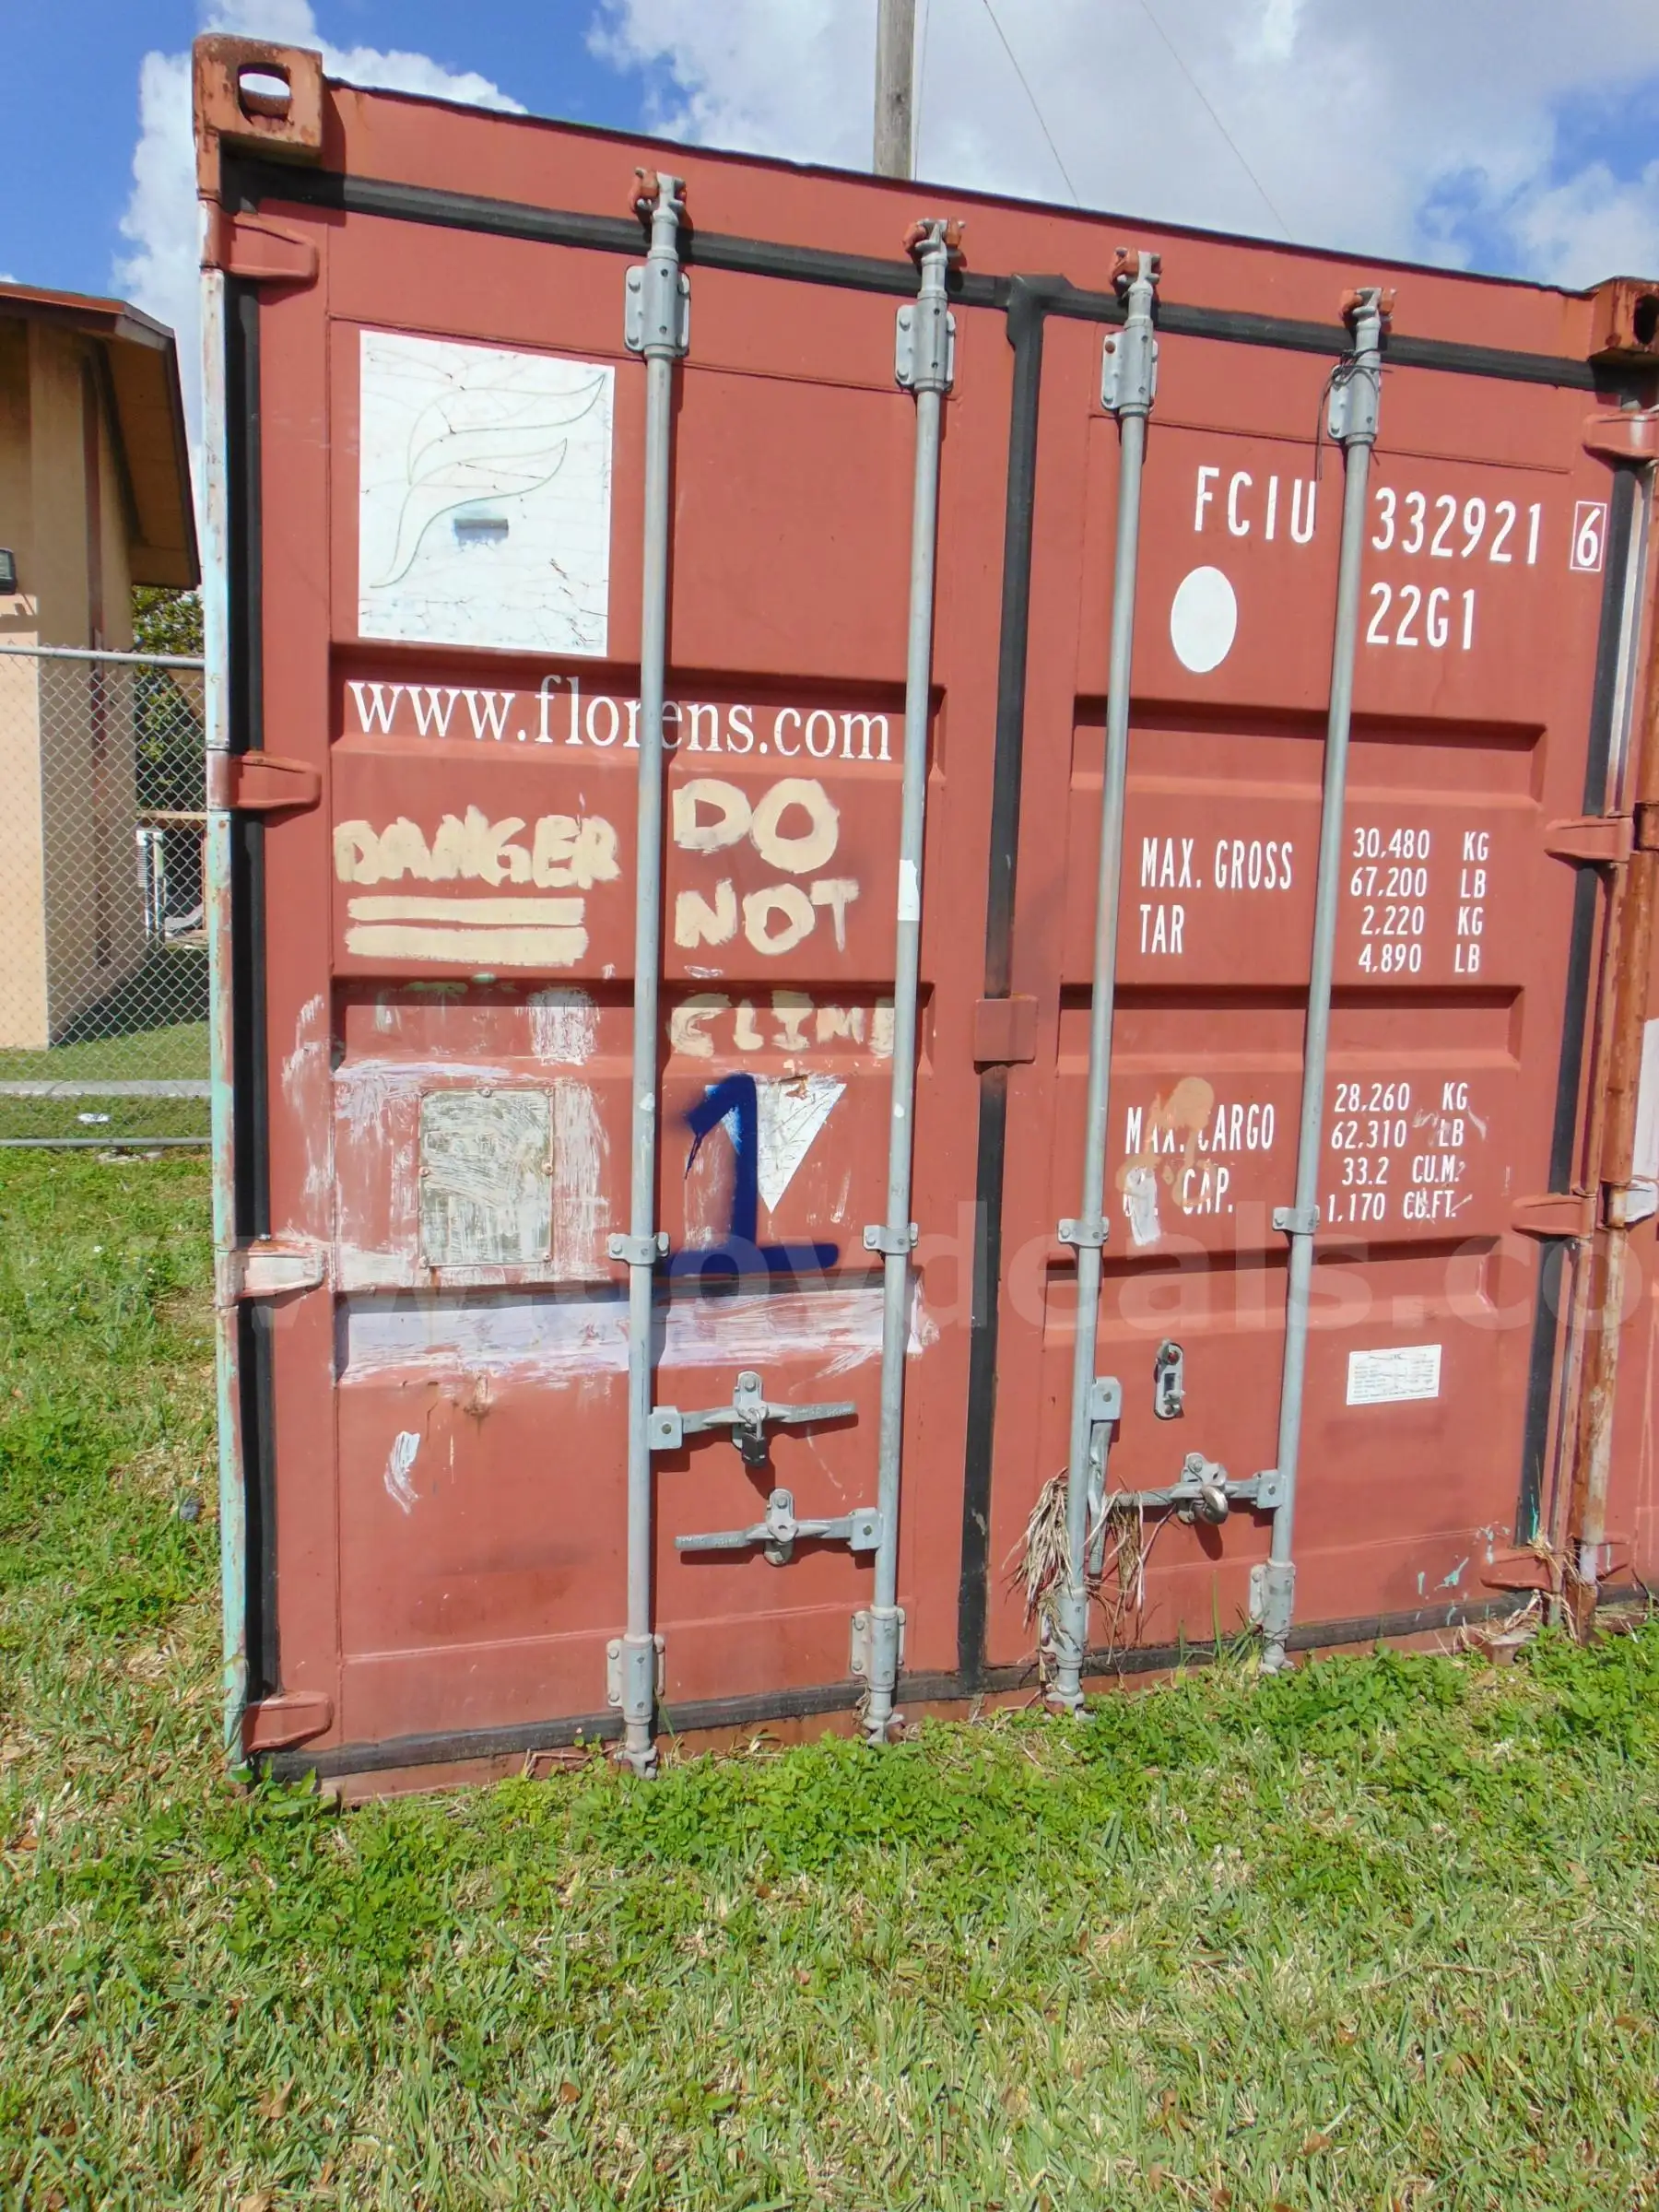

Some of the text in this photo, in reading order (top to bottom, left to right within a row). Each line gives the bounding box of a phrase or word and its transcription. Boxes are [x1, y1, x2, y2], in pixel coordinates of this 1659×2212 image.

[1194, 465, 1602, 567] FCIU 332921 6
[1366, 582, 1475, 650] 22G1
[347, 674, 893, 762] www.florens.com
[333, 805, 622, 889] DANGER
[673, 778, 841, 874] DO
[1352, 827, 1489, 861] 30,480 KG
[1140, 837, 1294, 890] MAX. GROSS
[1350, 866, 1487, 899] 67,200 LB
[674, 878, 860, 956] NOT
[1139, 904, 1184, 954] TAR
[1360, 905, 1484, 935] 2,220 KG
[1358, 943, 1480, 973] 4,890 LB
[1334, 1082, 1469, 1112] 28,260 KG
[1331, 1118, 1465, 1149] 62,310 LB
[1182, 1167, 1234, 1216] CAP.
[1341, 1154, 1459, 1185] 33.2 CU.M.
[1328, 1190, 1457, 1223] 1,170 CU.FT.
